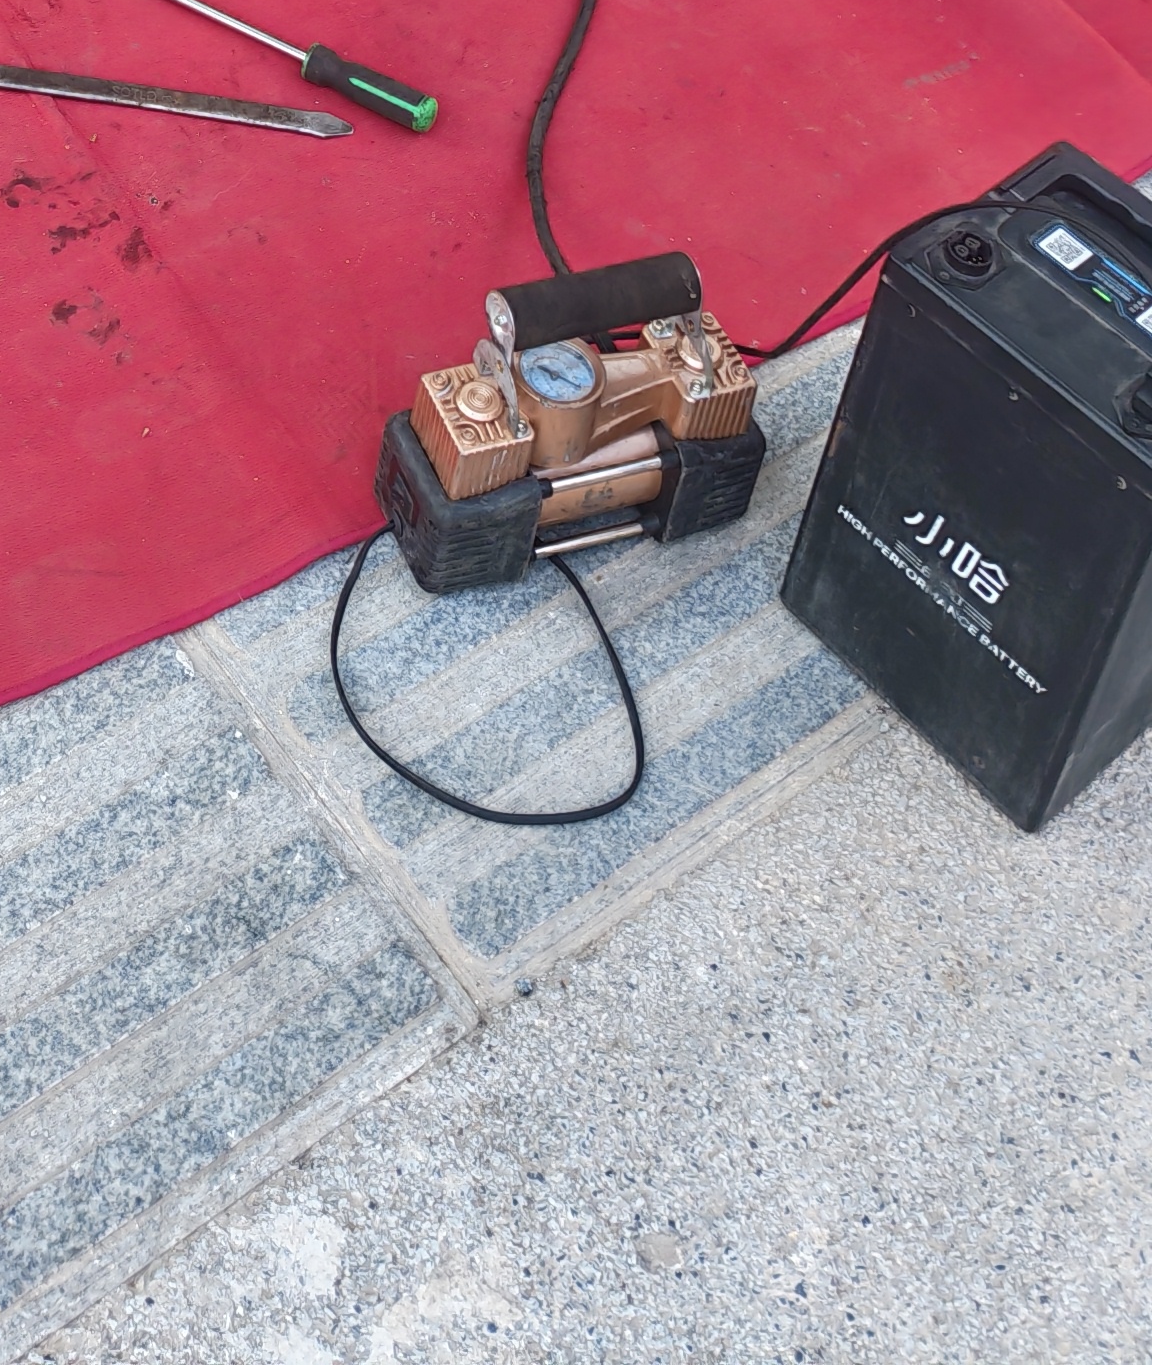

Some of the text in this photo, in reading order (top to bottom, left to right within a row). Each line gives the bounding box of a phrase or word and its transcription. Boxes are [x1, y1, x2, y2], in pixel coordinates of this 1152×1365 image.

[837, 505, 873, 540] HIGH
[978, 633, 1048, 694] BATTERY
[904, 512, 1009, 604] 小哈
